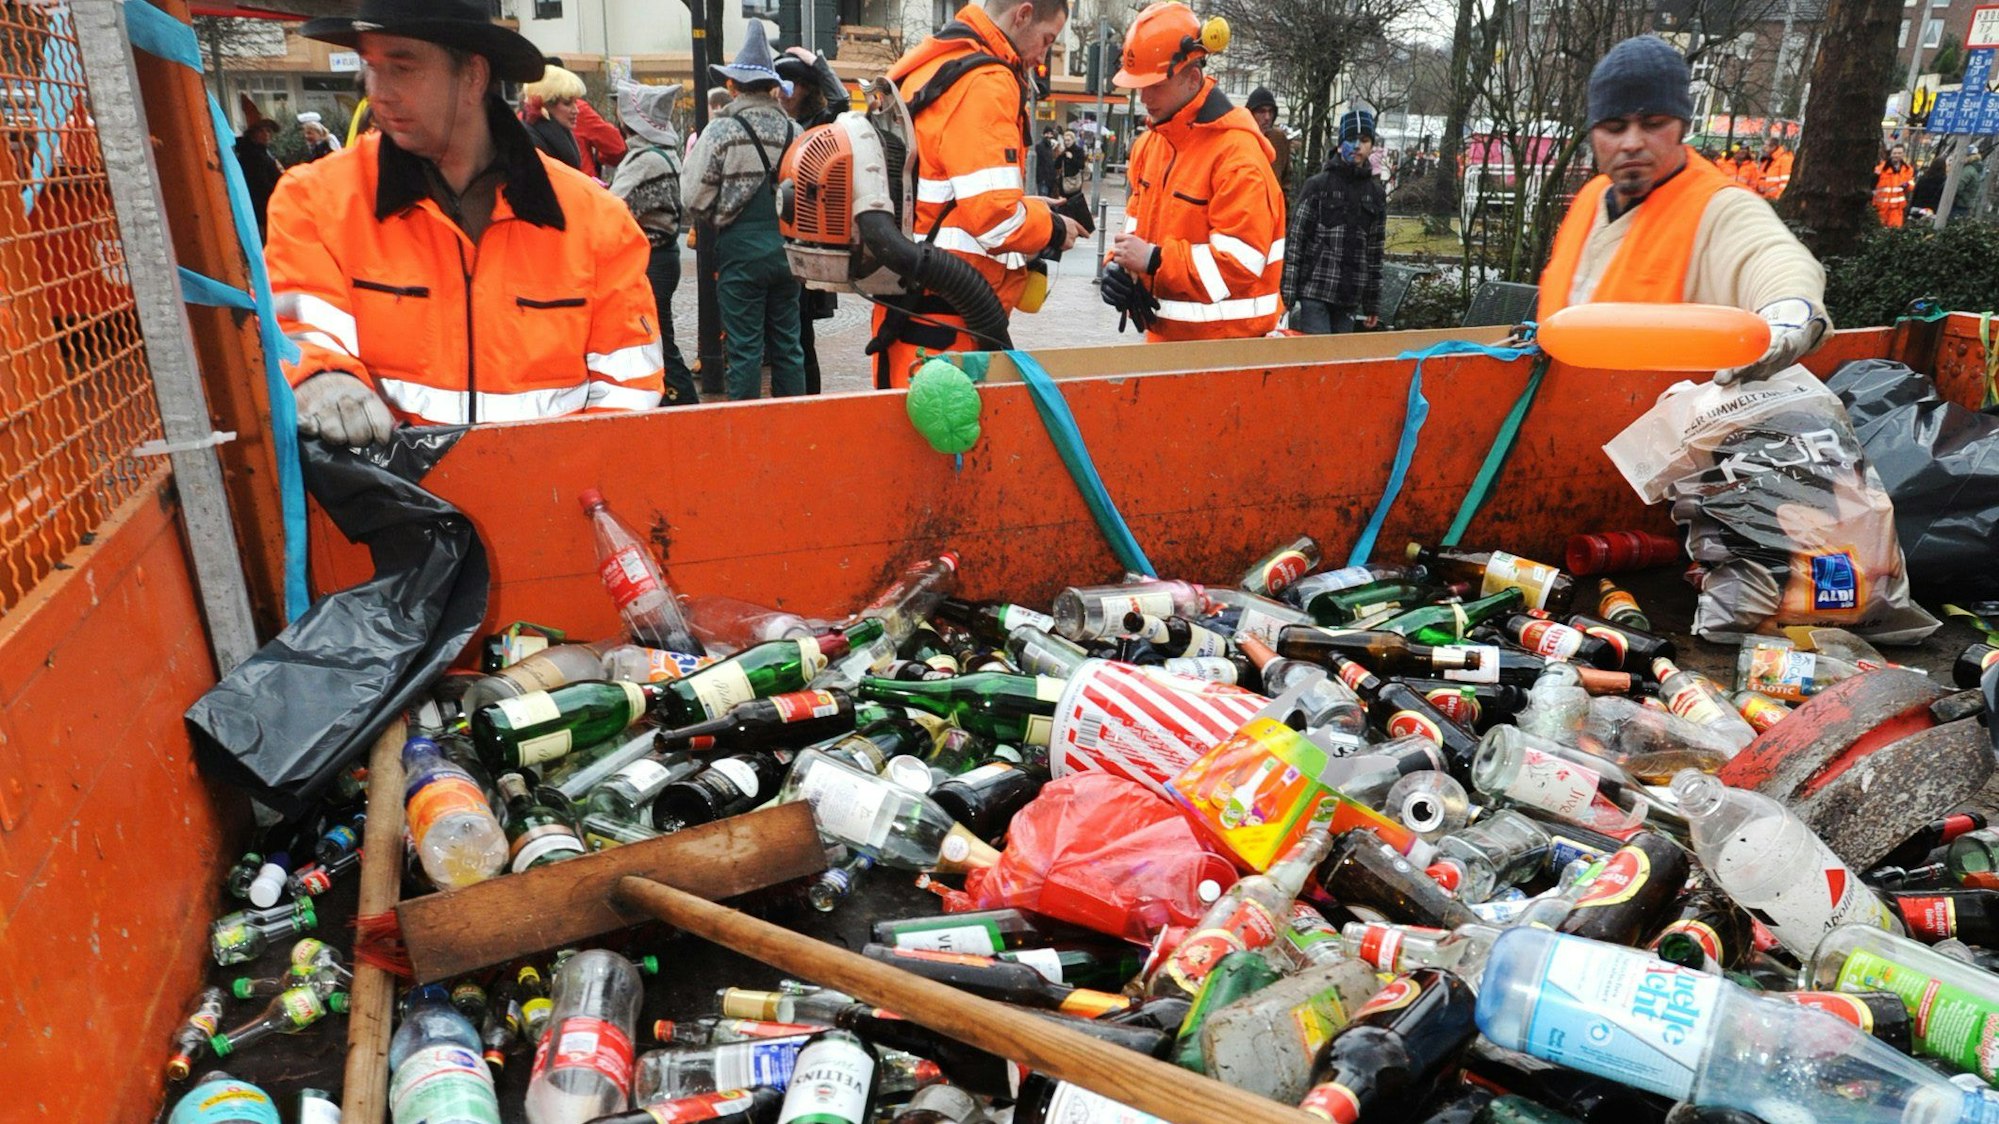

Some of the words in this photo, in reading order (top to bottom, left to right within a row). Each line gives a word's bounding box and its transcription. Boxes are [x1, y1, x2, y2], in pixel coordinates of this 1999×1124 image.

[1707, 391, 1758, 420] UMWELT
[1737, 458, 1852, 494] STYLING
[1818, 588, 1855, 603] ALDI
[1751, 683, 1795, 696] EXOTIC
